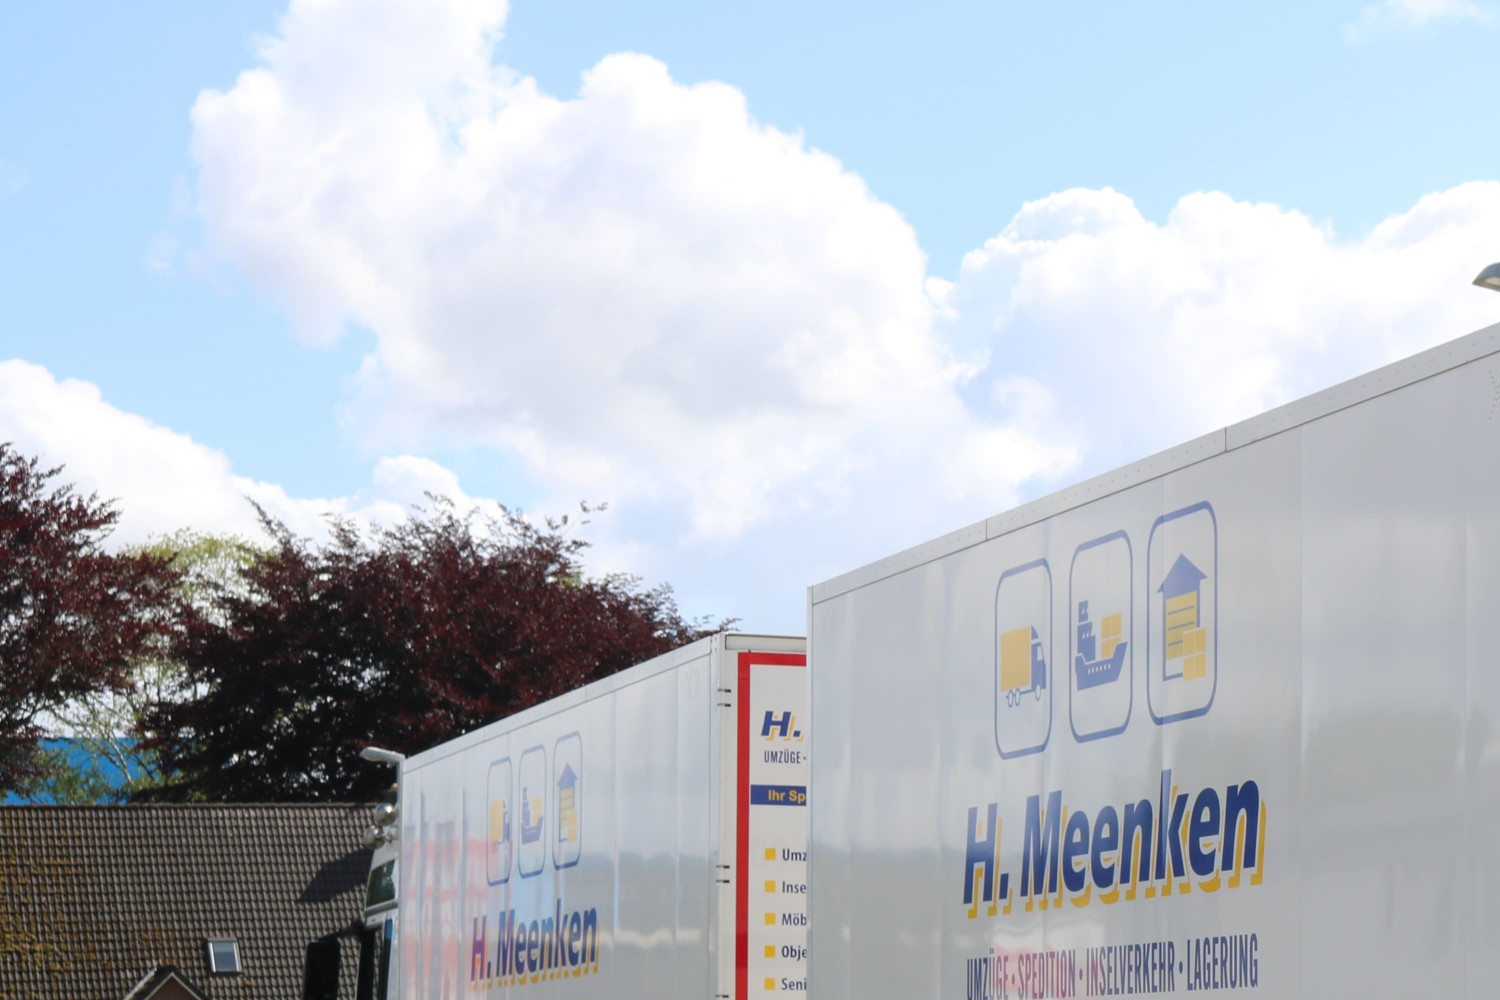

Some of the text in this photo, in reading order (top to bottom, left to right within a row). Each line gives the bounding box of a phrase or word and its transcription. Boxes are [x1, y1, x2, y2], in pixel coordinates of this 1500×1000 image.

[761, 711, 803, 741] H.
[764, 750, 801, 764] UMZÜGE
[768, 790, 785, 801] Ihr
[963, 769, 1266, 918] H. Meenken
[471, 898, 599, 991] H. Meenken
[1017, 949, 1076, 1000] SPEDITION
[1086, 940, 1176, 997] INSELVERKEHR
[1186, 933, 1259, 991] LAGERUNG
